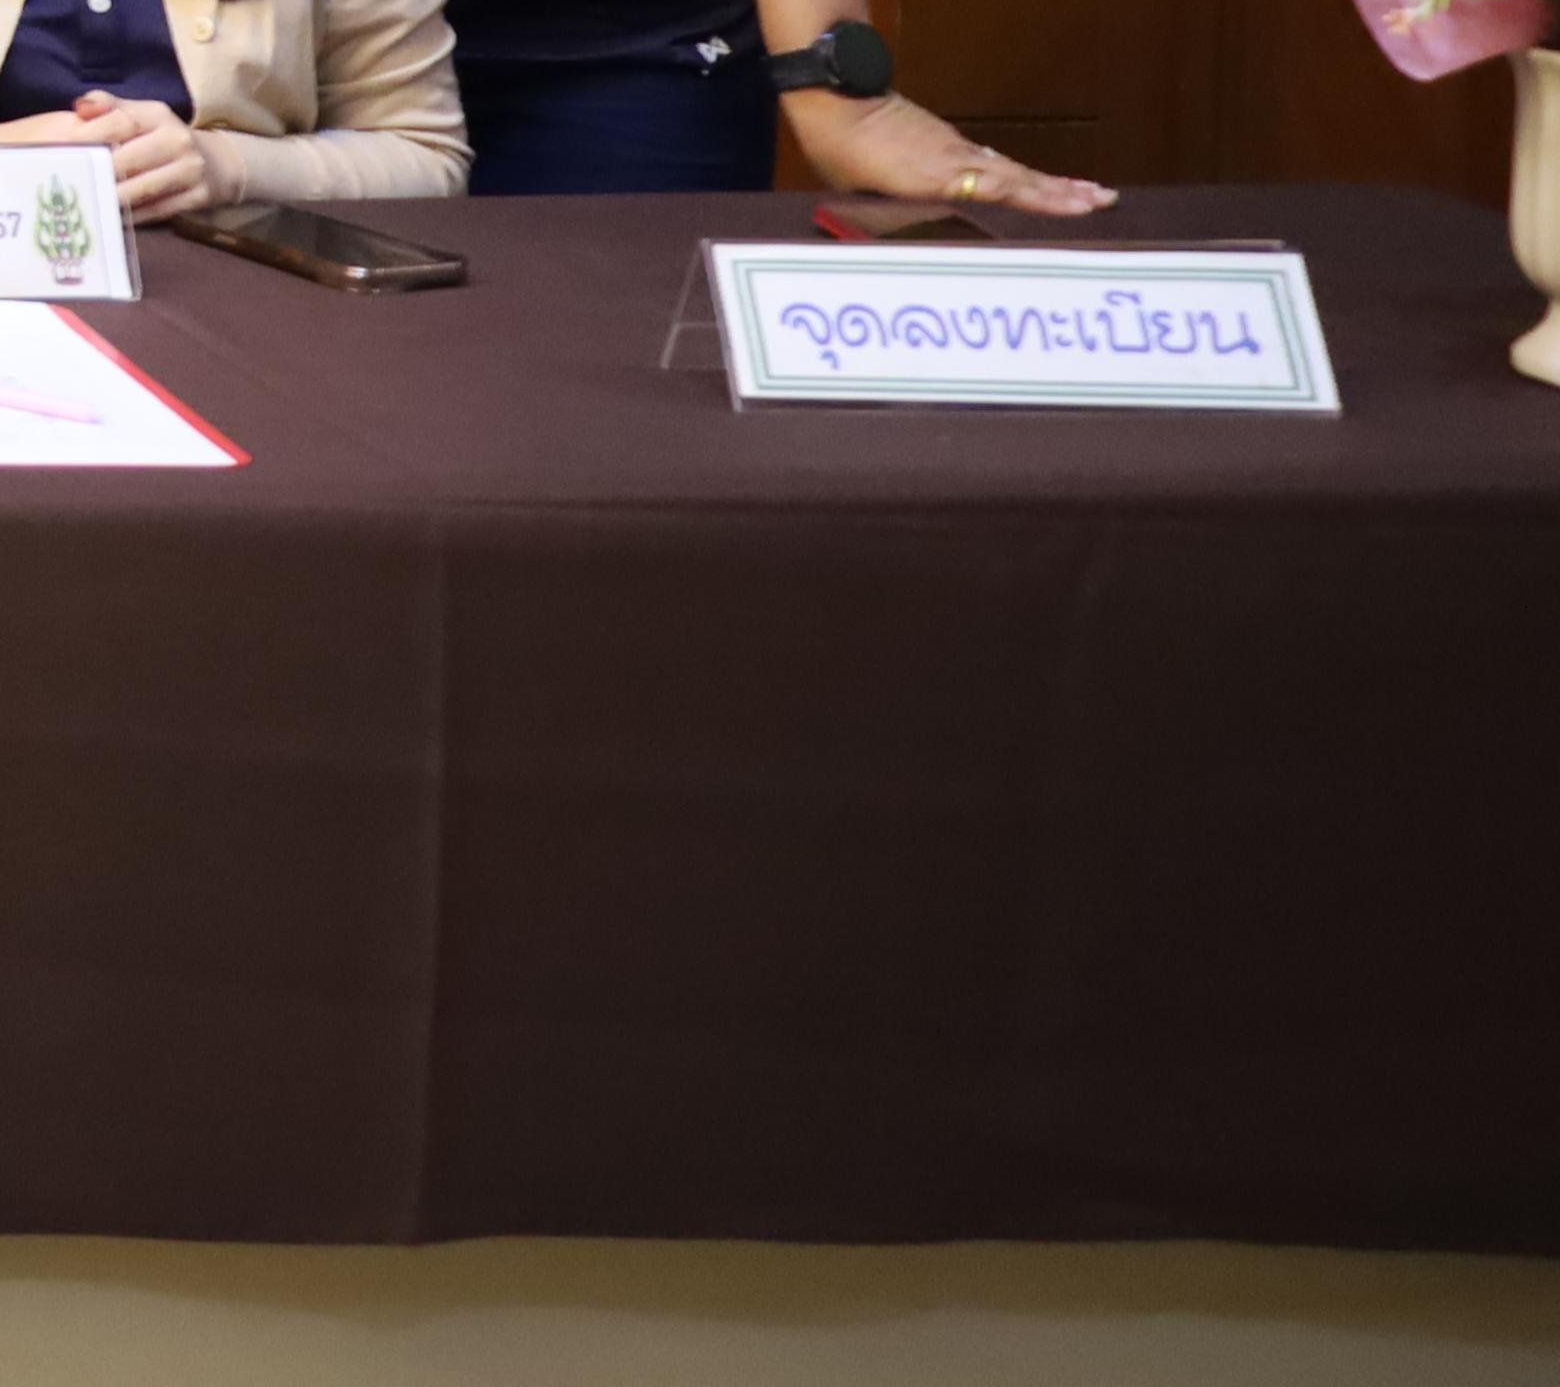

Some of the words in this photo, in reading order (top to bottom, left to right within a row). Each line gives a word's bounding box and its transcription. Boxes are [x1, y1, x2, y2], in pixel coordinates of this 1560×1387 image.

[779, 290, 1262, 371] จุดลงทะเบียน
